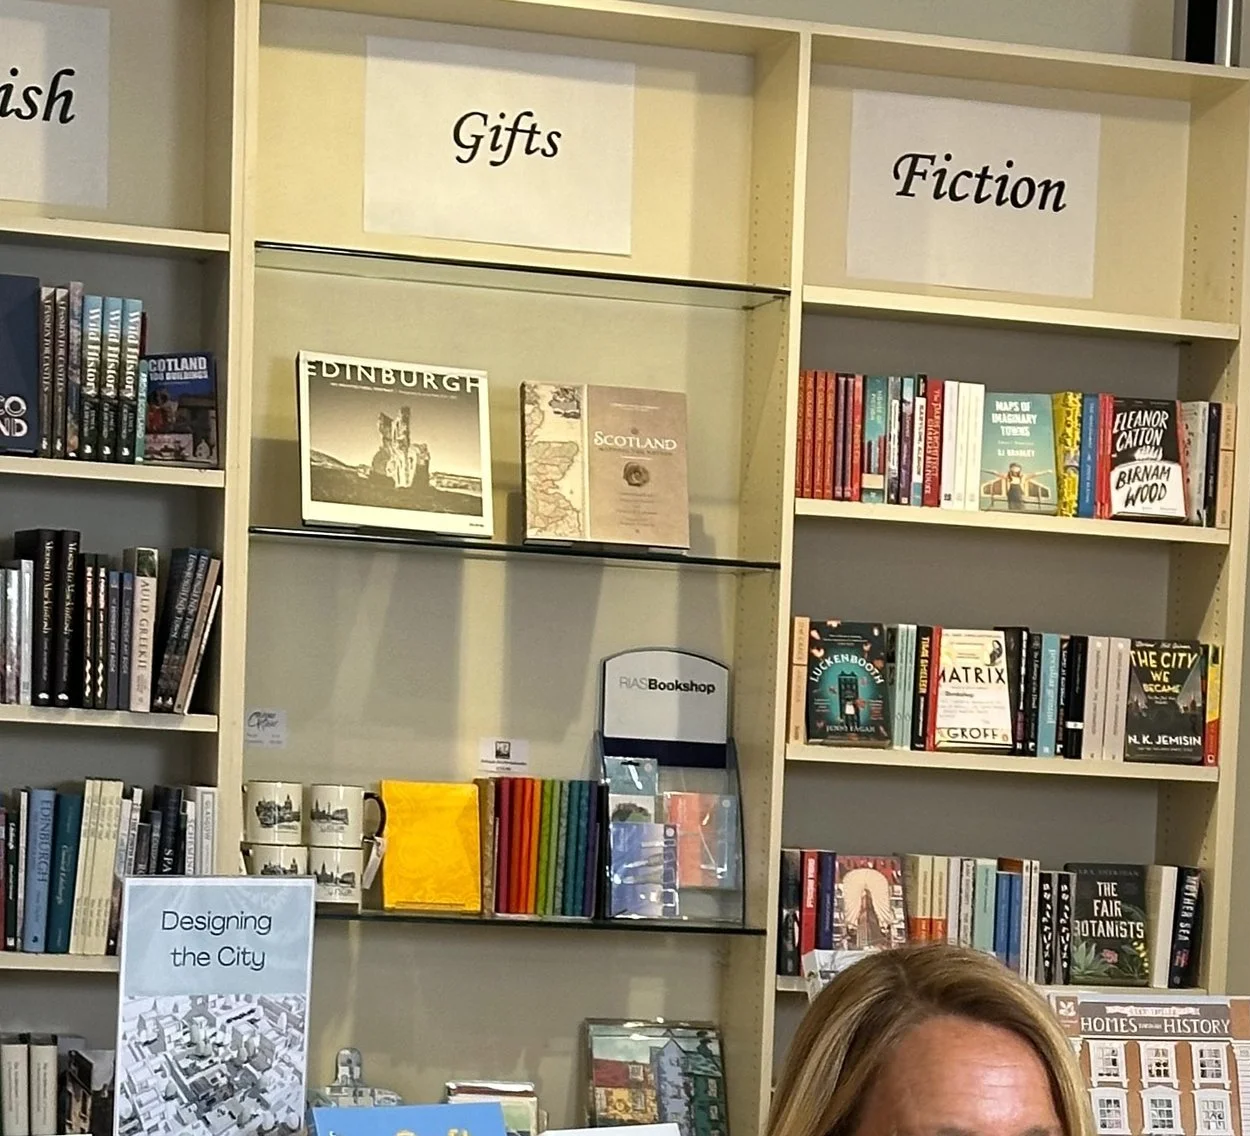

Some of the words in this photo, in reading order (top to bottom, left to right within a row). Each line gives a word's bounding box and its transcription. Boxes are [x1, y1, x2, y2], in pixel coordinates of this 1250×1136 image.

[453, 110, 562, 166] Gifts
[892, 153, 1067, 213] Fiction
[88, 308, 101, 341] Wild
[108, 309, 120, 343] Wild
[126, 310, 140, 344] Wild
[84, 343, 100, 398] History
[104, 345, 119, 399] History
[123, 346, 139, 401] History
[995, 400, 1020, 412] MAPS
[1021, 401, 1031, 412] OF
[992, 413, 1038, 426] IMAGINARY
[1000, 426, 1031, 437] TOWNS
[1113, 409, 1170, 434] ELEANOR
[1115, 427, 1163, 451] CATTON
[1115, 465, 1171, 490] BIRNAM
[1124, 482, 1168, 509] WOOD
[139, 579, 151, 614] AULD
[137, 618, 149, 671] GREEKIE
[808, 652, 885, 685] LUCKENBOOTH
[1046, 648, 1057, 687] peculiar
[1131, 650, 1159, 668] THE
[1160, 651, 1198, 669] CITY
[1142, 684, 1182, 694] BECAME
[1150, 670, 1171, 682] WE
[1045, 688, 1056, 724] ground
[946, 727, 999, 740] GROFF
[1141, 735, 1154, 745] K.
[1155, 735, 1202, 746] JEMISIN
[36, 799, 53, 883] EDINBURGH
[162, 848, 174, 873] SPA
[1096, 881, 1119, 897] THE
[1179, 875, 1199, 918] MOTHER
[1093, 899, 1123, 918] FAIR
[161, 910, 272, 936] Designing
[1074, 920, 1145, 939] BOTANISTS
[1177, 922, 1191, 942] SEA
[170, 946, 211, 967] the
[217, 945, 266, 971] City
[1081, 1015, 1138, 1034] HOMES
[1163, 1017, 1230, 1034] HISTORY
